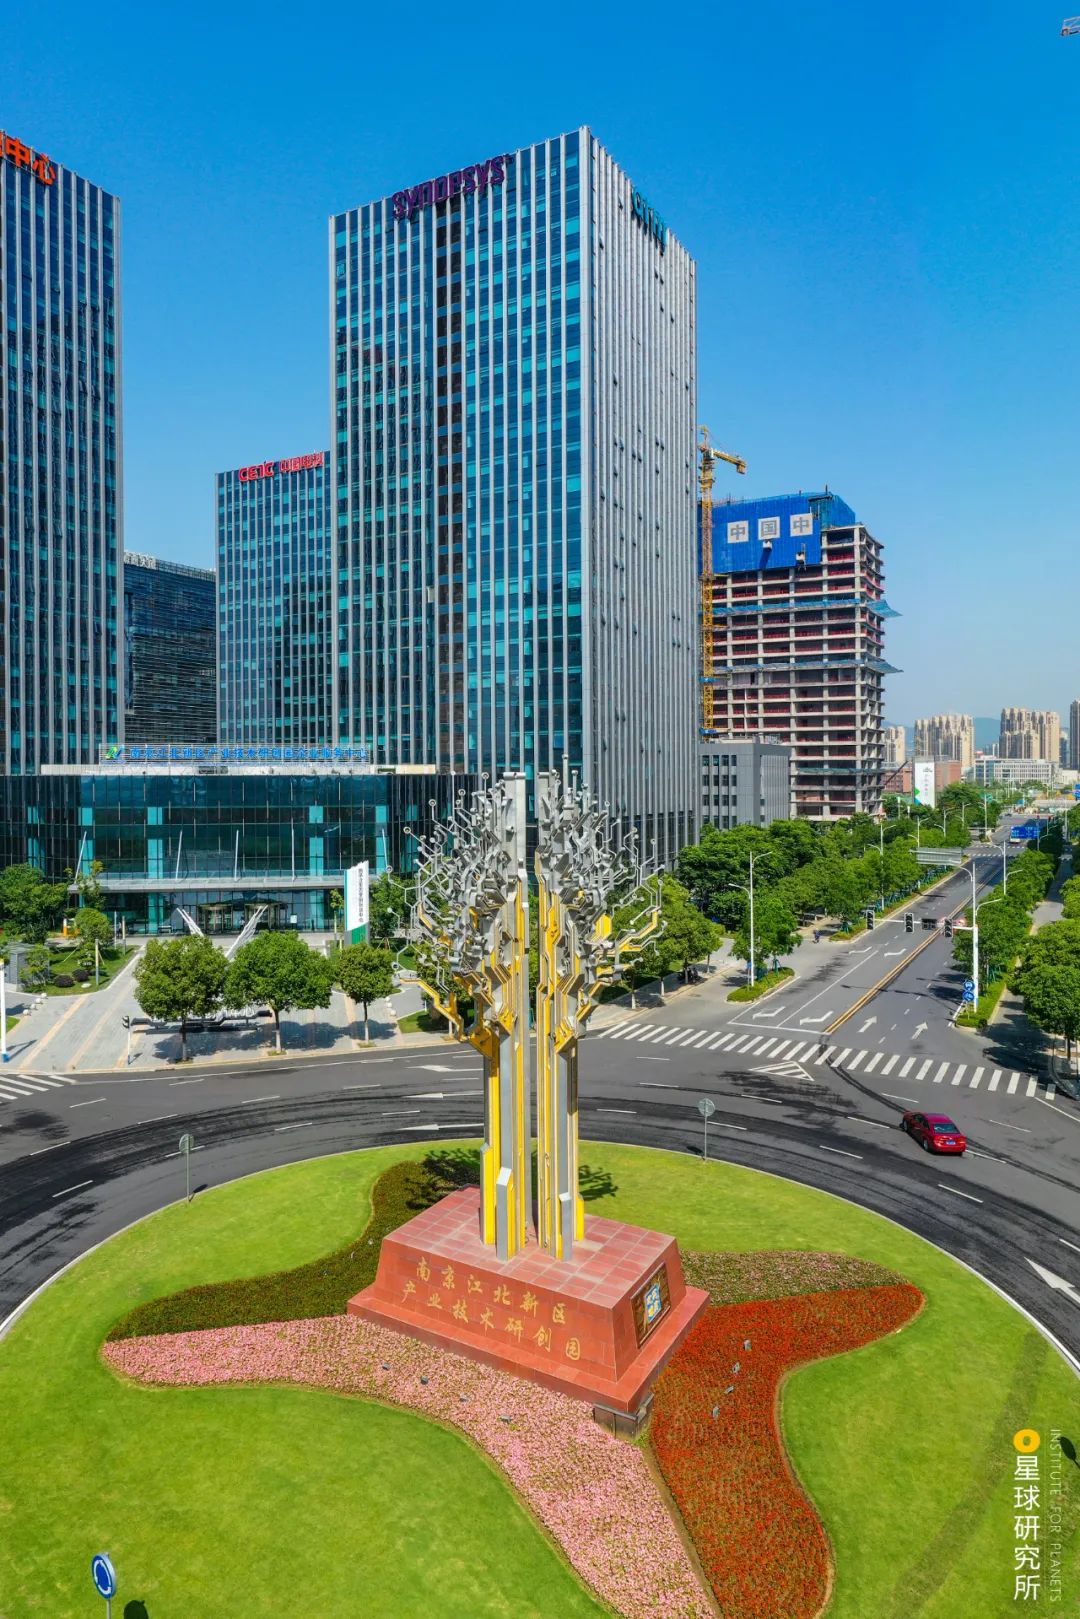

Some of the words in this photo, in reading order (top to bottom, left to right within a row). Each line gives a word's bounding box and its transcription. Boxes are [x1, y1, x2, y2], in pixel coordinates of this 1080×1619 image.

[0, 131, 56, 186] 中心
[402, 1280, 581, 1361] 产业技术研创园
[416, 1256, 567, 1325] 南京江北新区
